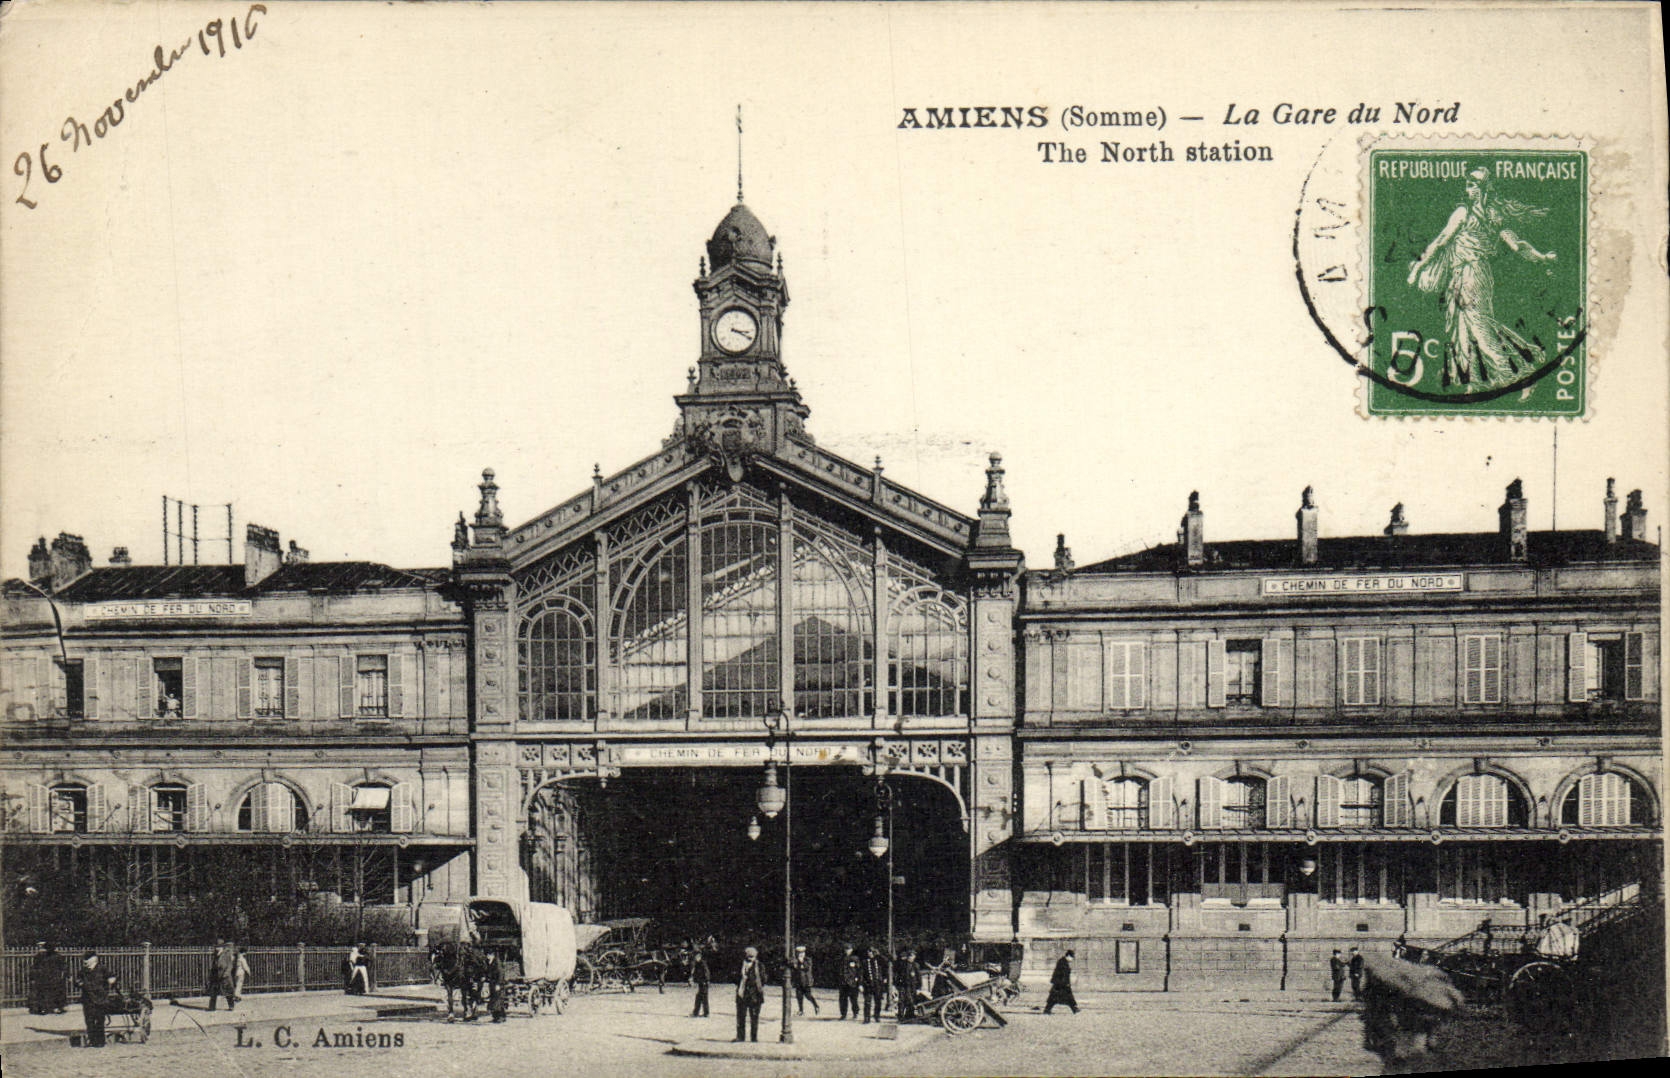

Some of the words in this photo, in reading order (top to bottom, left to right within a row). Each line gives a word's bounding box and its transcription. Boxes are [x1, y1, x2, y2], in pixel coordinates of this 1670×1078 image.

[14, 143, 63, 210] 26
[1495, 160, 1577, 181] FRANÇAISE
[1555, 315, 1577, 401] POSTES
[1282, 580, 1326, 591] CHEMIN
[1333, 579, 1348, 590] DE
[1356, 579, 1380, 589] FER
[1387, 578, 1404, 588] DU
[1411, 577, 1443, 588] NORD
[143, 605, 156, 615] DE
[163, 604, 183, 615] FER
[188, 603, 202, 614] DU
[208, 603, 236, 614] NORD
[650, 747, 699, 758] CHEMIN
[707, 748, 725, 759] DE
[734, 748, 761, 757] FER
[796, 747, 831, 757] NORD
